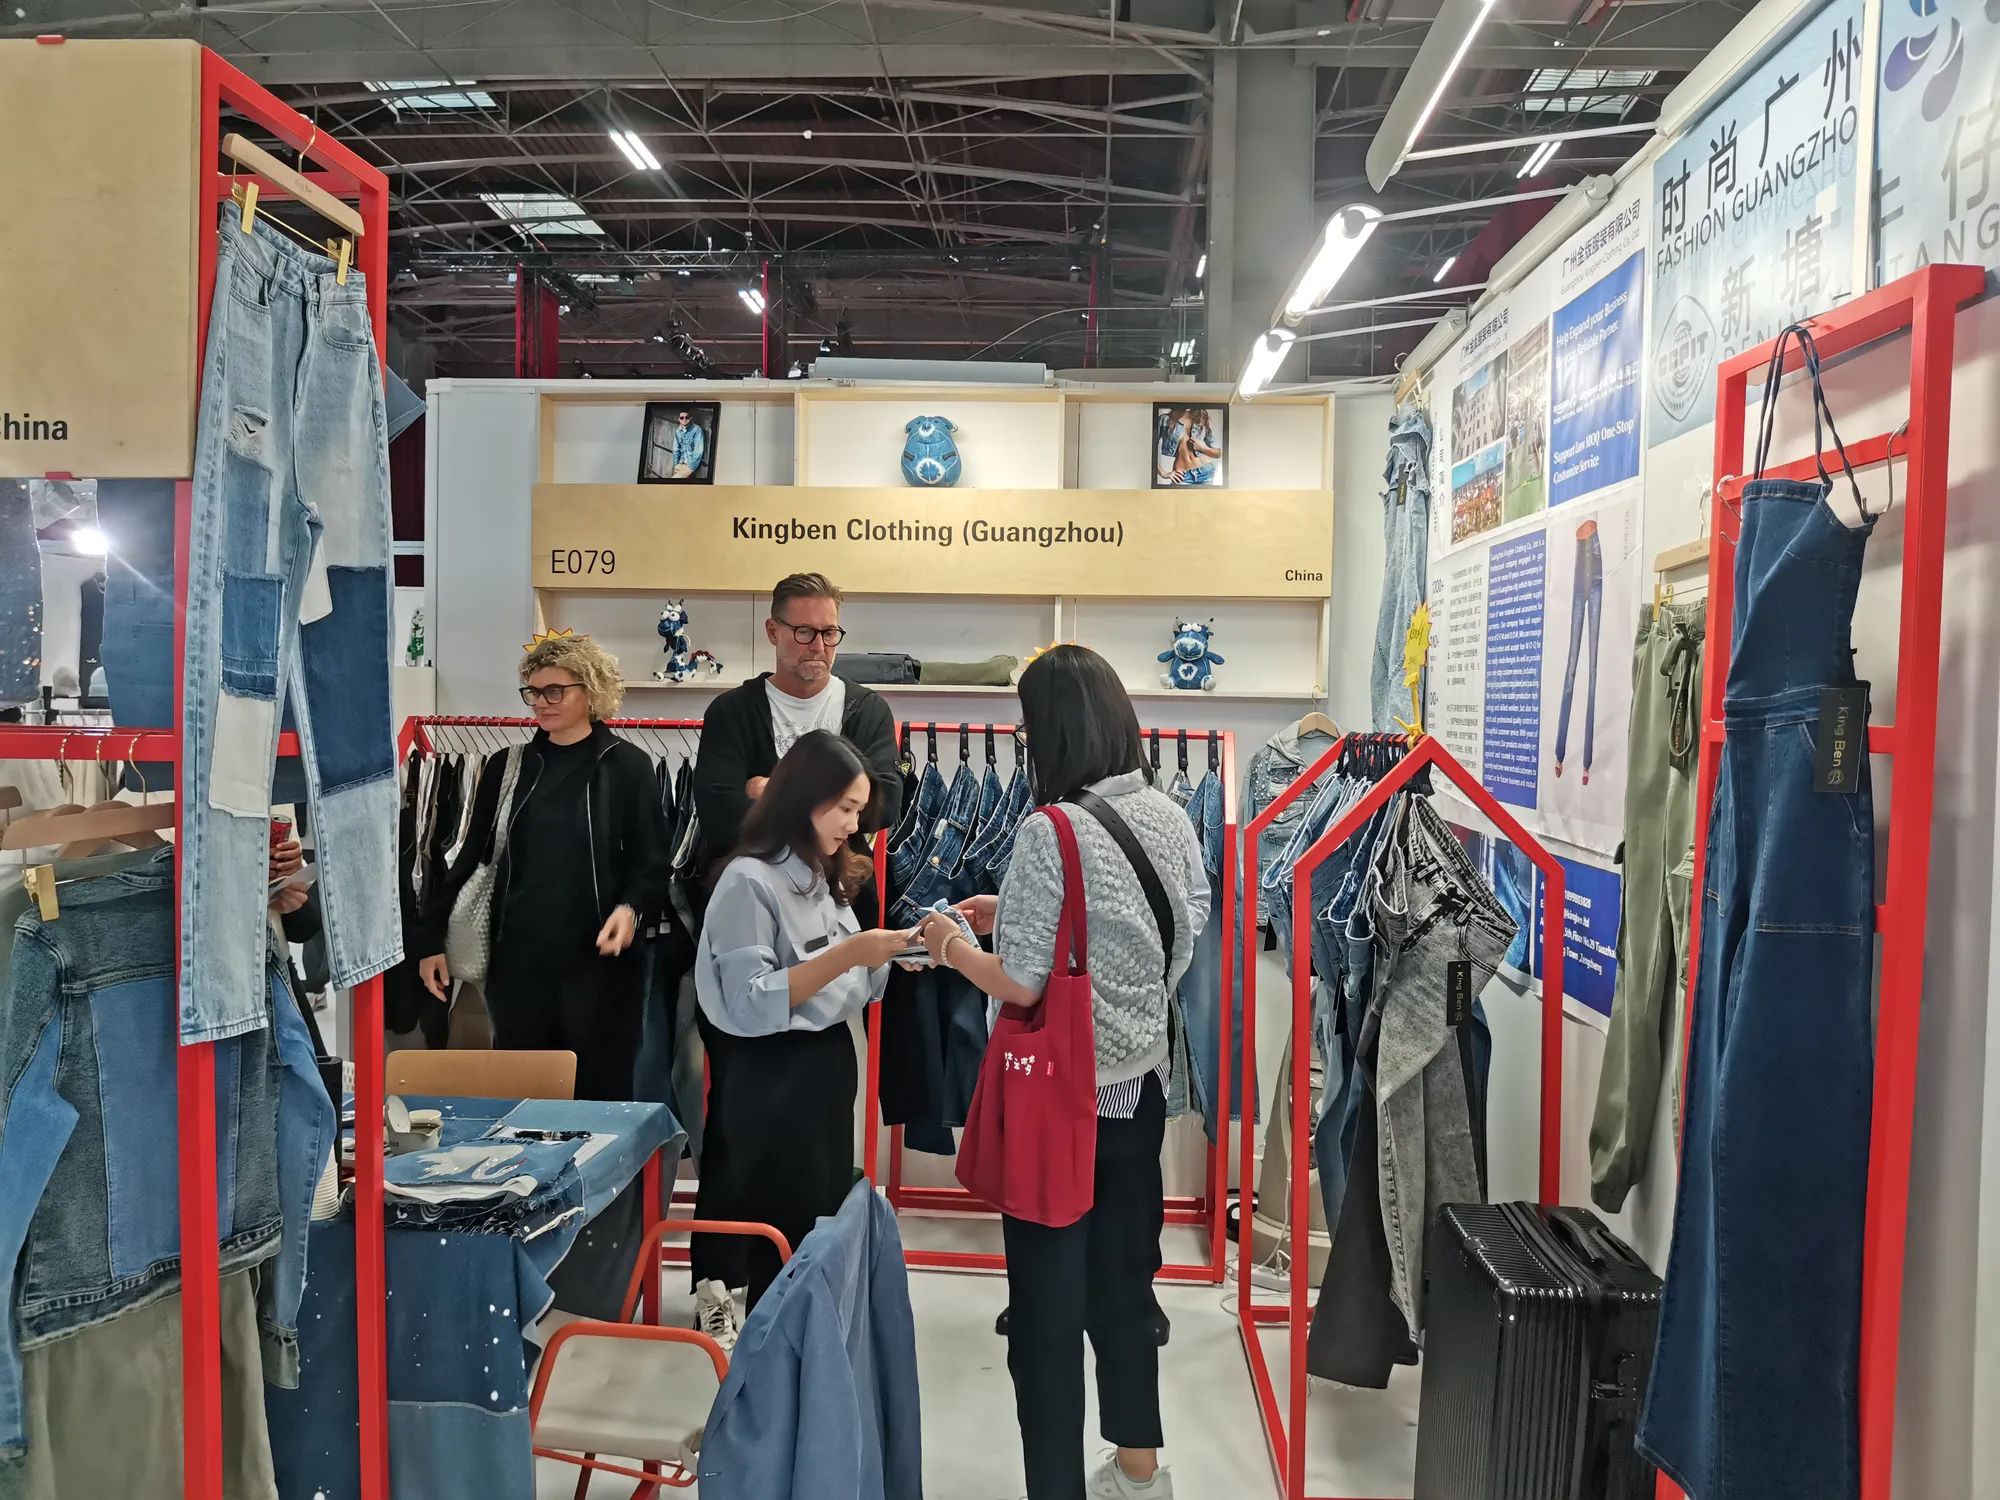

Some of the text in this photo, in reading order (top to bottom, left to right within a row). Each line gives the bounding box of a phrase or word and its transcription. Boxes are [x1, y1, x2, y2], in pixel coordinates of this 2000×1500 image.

[1662, 16, 1860, 242] 时尚广州
[1657, 105, 1858, 279] FASHION GUANGZHO
[1556, 291, 1627, 349] Help Expand your Business
[1577, 333, 1598, 354] Reliable
[1658, 331, 1709, 377] CCPIT
[0, 413, 68, 440] hina
[1553, 419, 1634, 464] Support Low MOQ One-Stop
[1580, 454, 1600, 473] Service
[732, 517, 1124, 548] Kingben Clothing (Guangzhou)
[551, 549, 616, 574] E079
[1285, 569, 1323, 581] China
[1832, 706, 1849, 767] King Ben
[1566, 946, 1579, 961] Town
[1456, 971, 1464, 1011] King Ben
